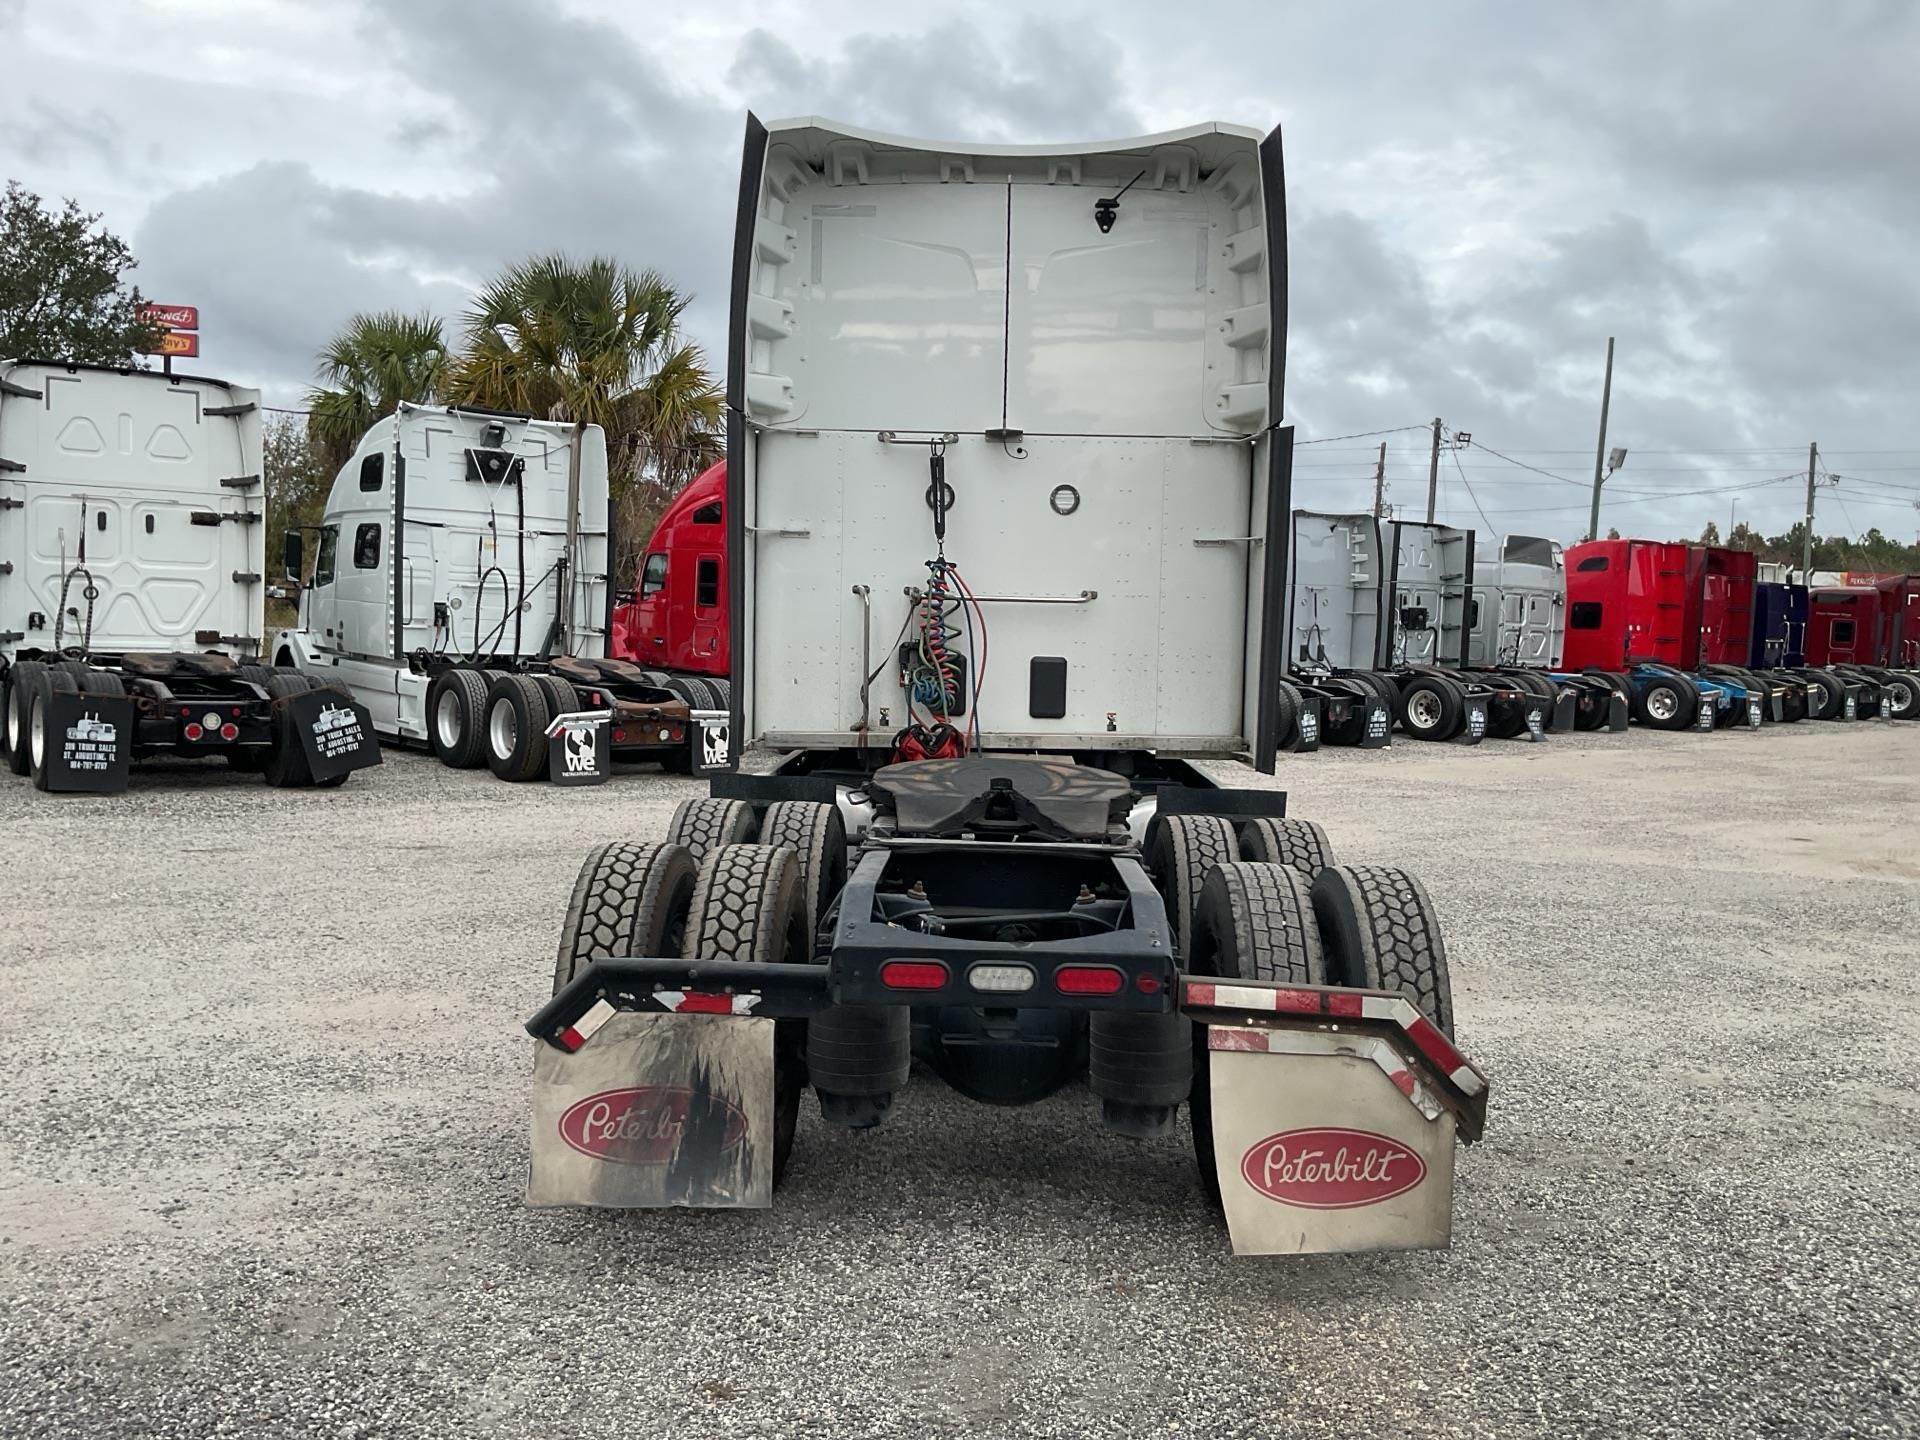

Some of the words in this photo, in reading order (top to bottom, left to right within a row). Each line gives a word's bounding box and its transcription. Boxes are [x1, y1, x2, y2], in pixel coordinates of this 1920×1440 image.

[345, 724, 361, 735] SALES
[98, 744, 116, 752] SALES
[1263, 1143, 1408, 1189] Peterbilt
